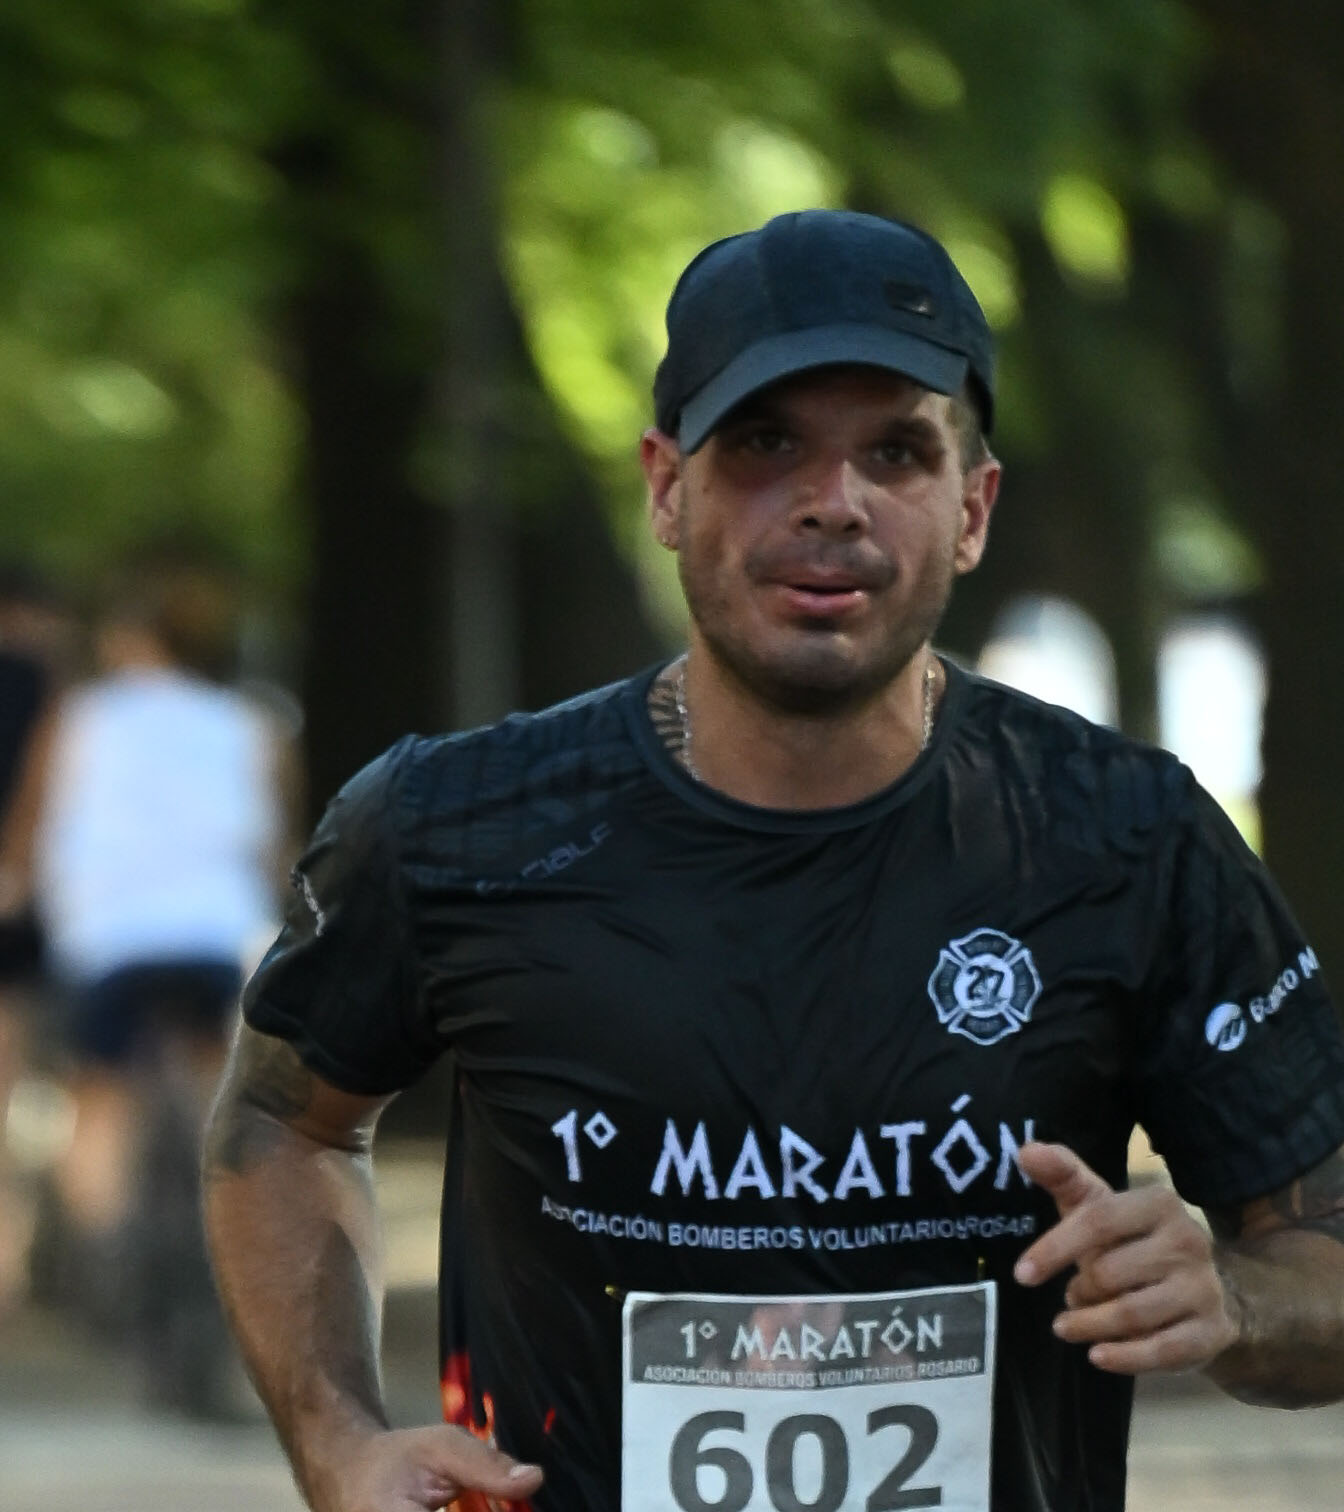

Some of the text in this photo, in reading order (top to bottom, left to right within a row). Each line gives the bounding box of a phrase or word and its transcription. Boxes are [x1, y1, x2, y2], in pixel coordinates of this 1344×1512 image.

[967, 964, 1005, 1001] 27
[551, 1094, 1036, 1203] 1º MARATÓN
[667, 1223, 806, 1251] BOMBEROS
[808, 1217, 968, 1251] VOLUNTARIOS
[730, 1305, 944, 1362] MARATÓN
[917, 1356, 982, 1377] ROSARIO
